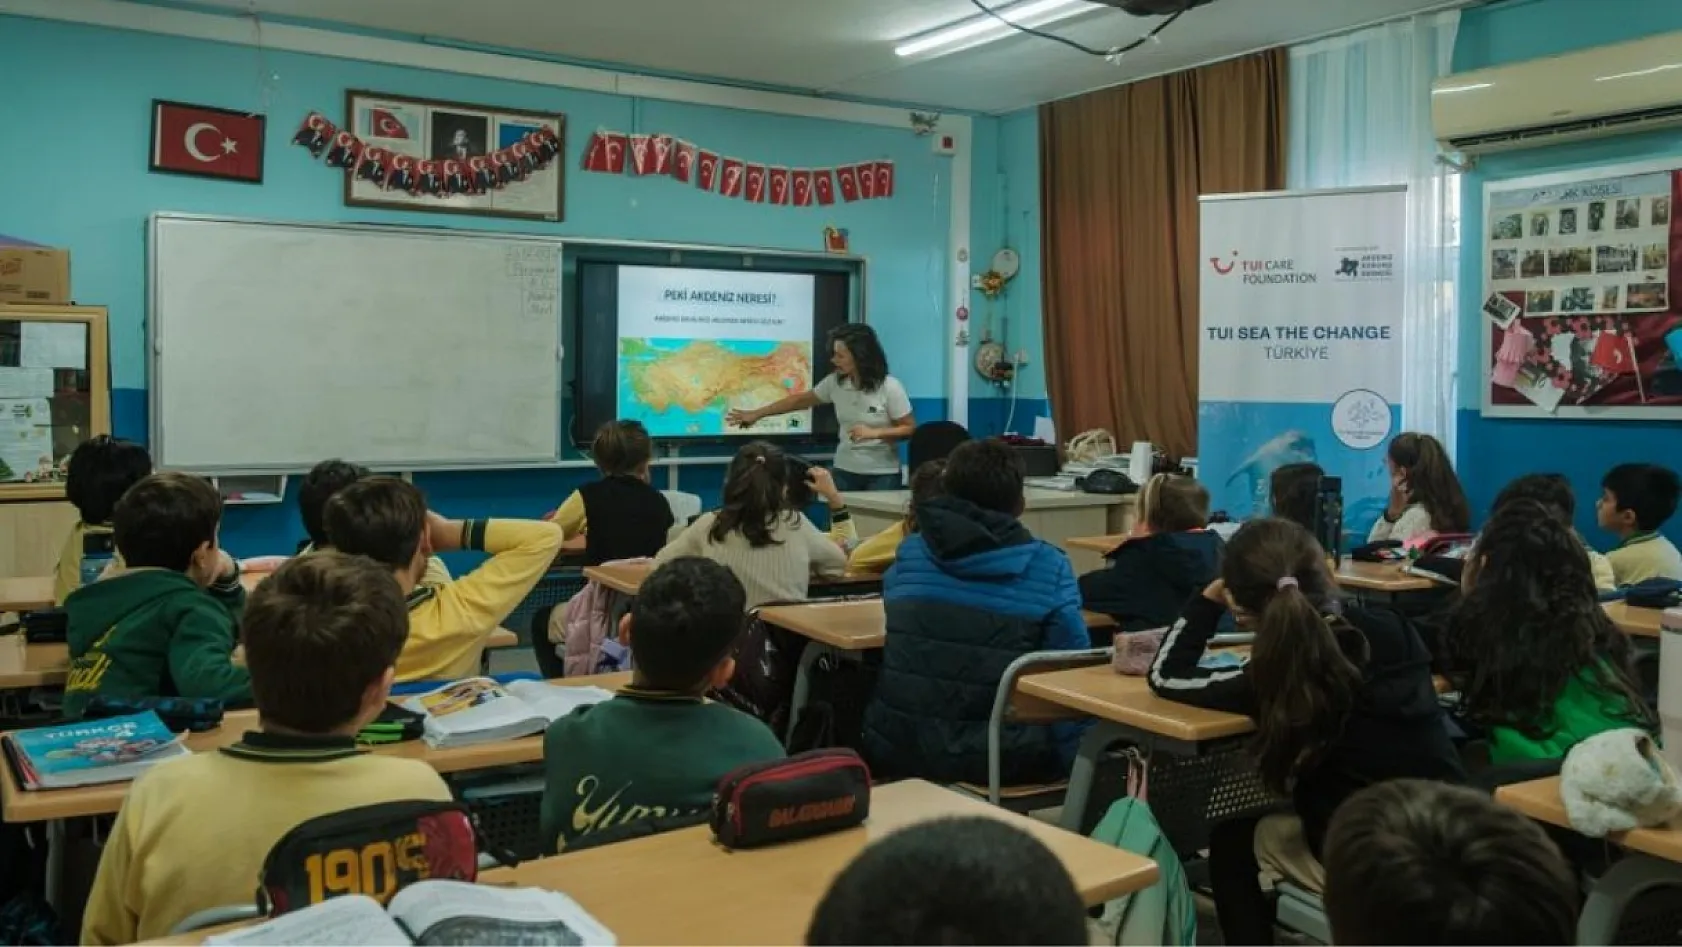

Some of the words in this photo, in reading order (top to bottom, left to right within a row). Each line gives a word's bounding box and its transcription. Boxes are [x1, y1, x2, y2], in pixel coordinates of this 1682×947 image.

[1242, 261, 1262, 271] TUI
[1265, 259, 1294, 270] CARE
[1243, 273, 1316, 284] FOUNDATION
[664, 288, 687, 300] PEKİ
[691, 289, 735, 302] AKDENİZ
[736, 291, 777, 304] NERESİ?
[1207, 327, 1233, 340] TUI
[1238, 326, 1270, 340] SEA
[1275, 326, 1308, 339] THE
[1313, 326, 1391, 340] CHANGE
[1264, 345, 1329, 360] TÜRKİYE
